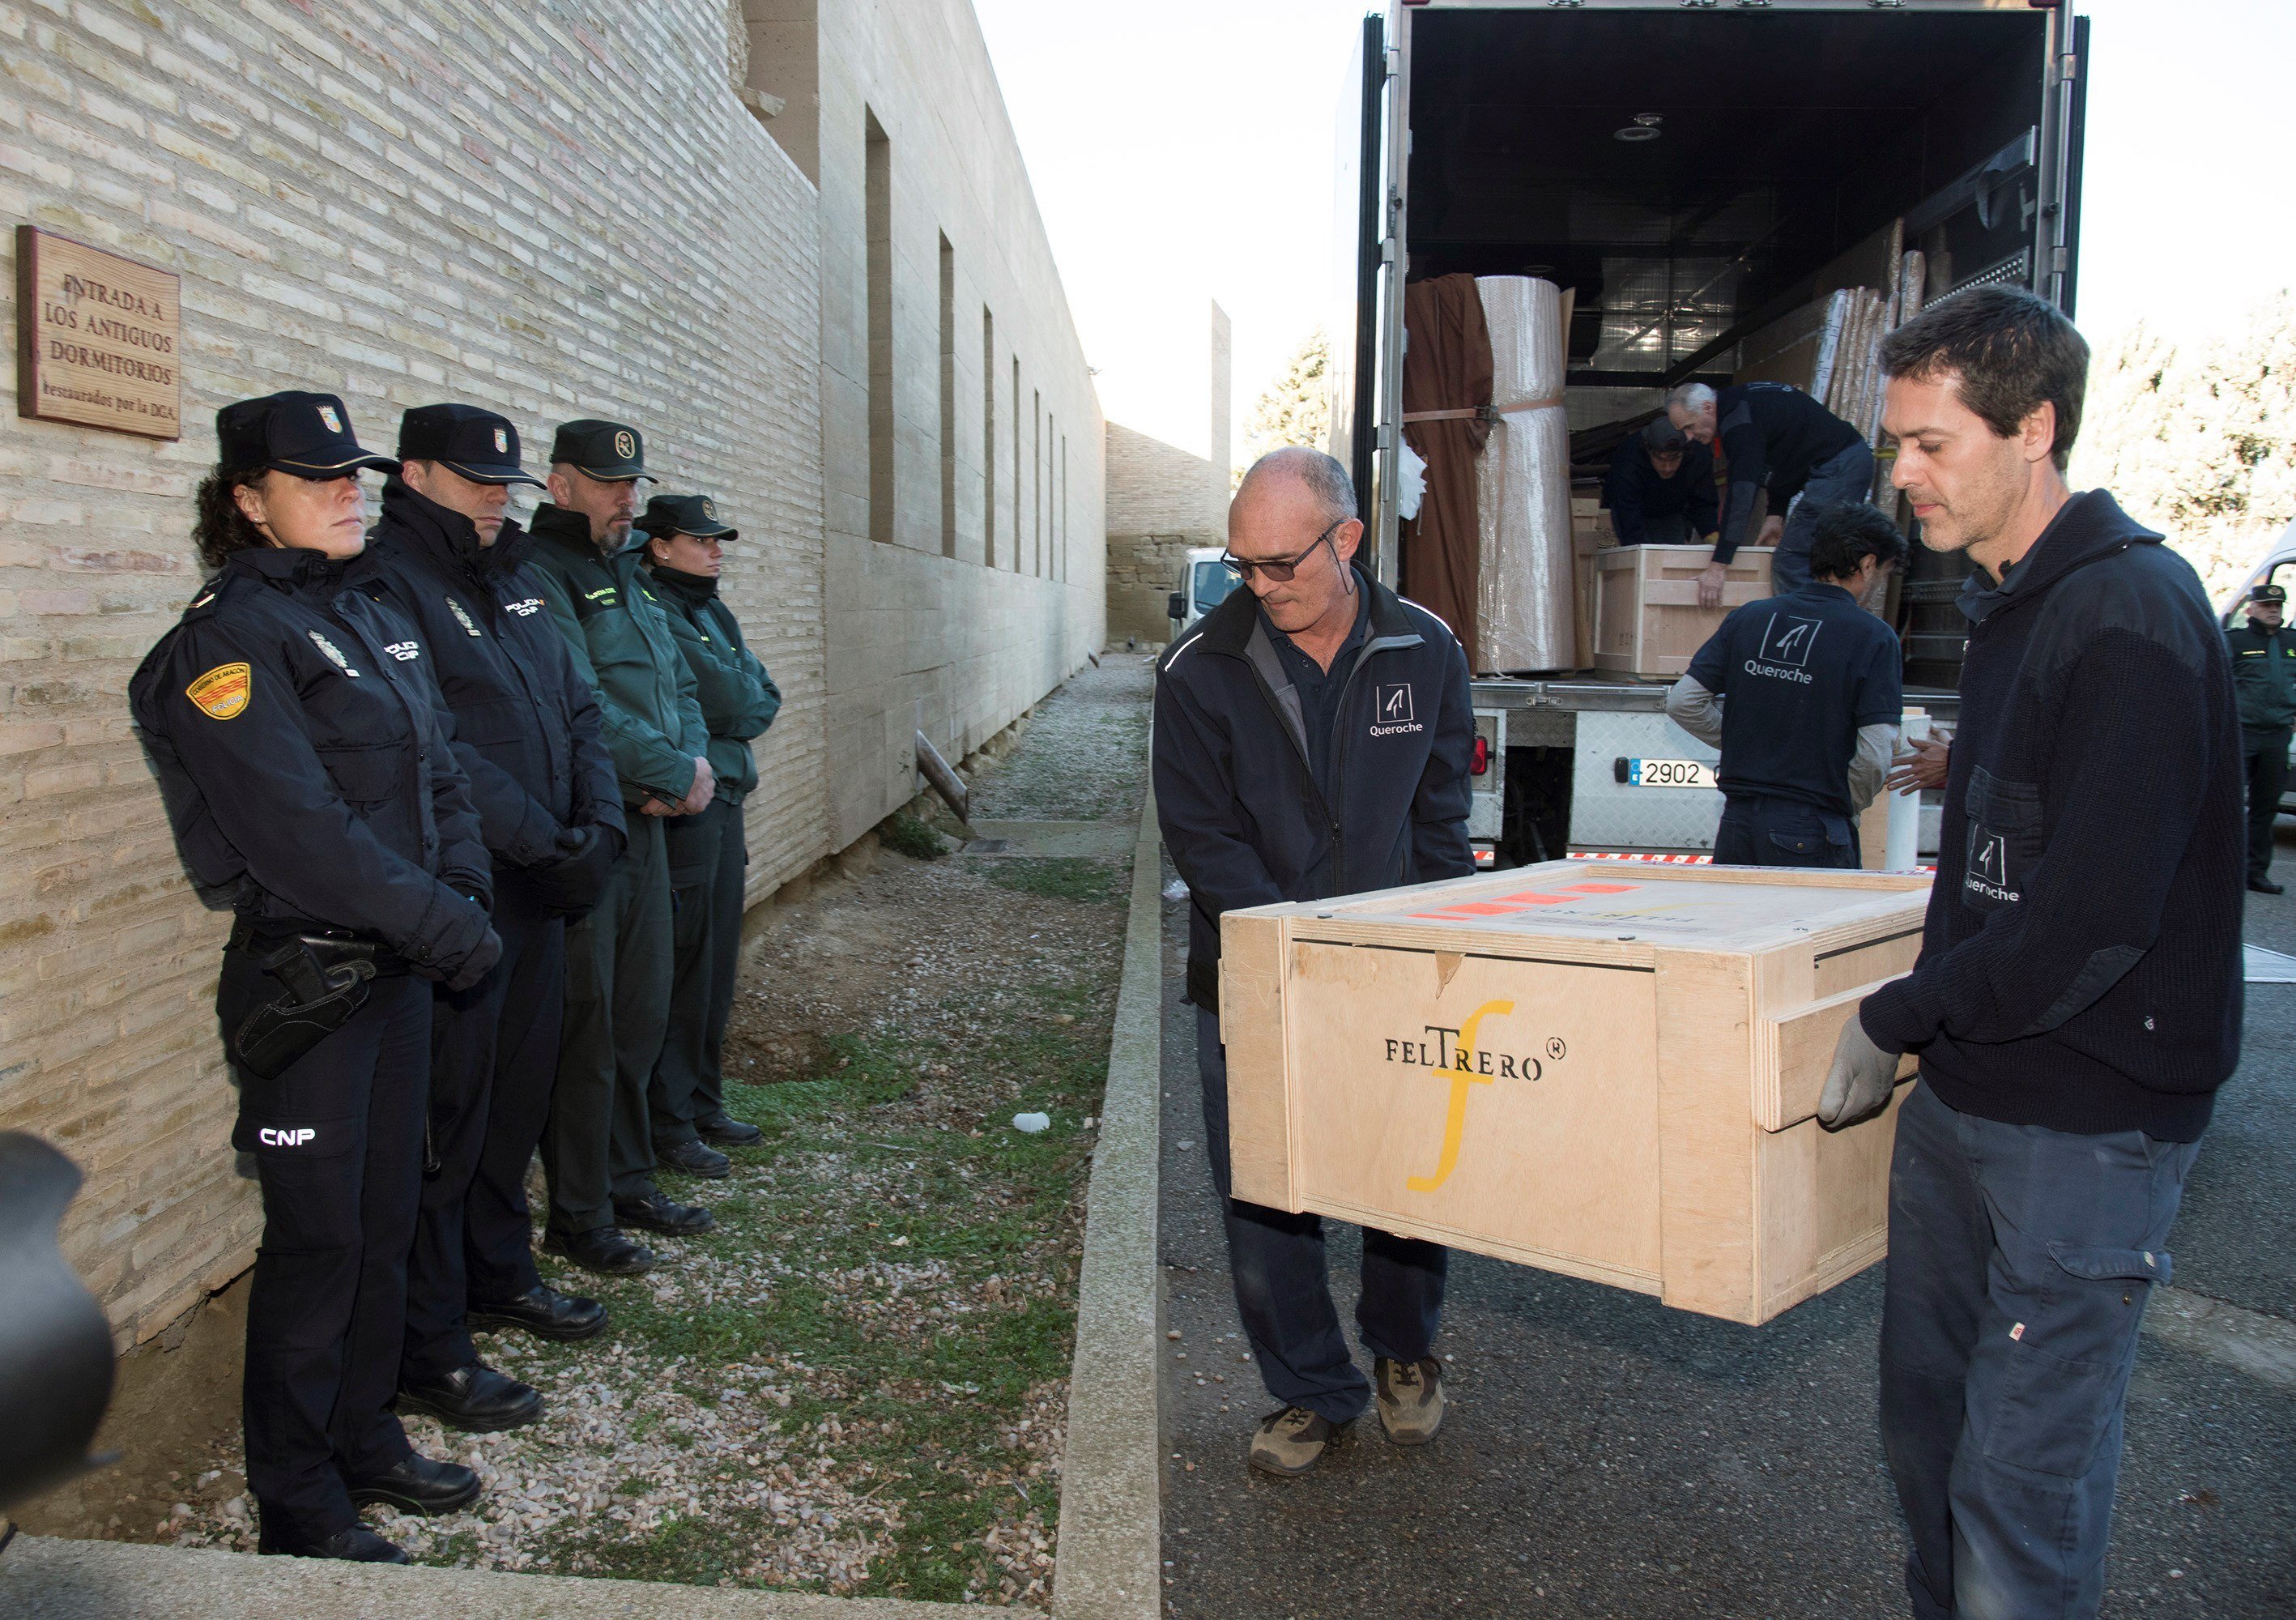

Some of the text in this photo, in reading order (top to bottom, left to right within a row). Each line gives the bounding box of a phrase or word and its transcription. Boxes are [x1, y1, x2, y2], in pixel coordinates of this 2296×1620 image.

[63, 273, 164, 322] ENTRADA A
[45, 301, 173, 353] LOS ANTIGUOS
[50, 340, 173, 386] DORMITORIOS
[1744, 660, 1813, 684] Queroche
[1370, 723, 1424, 737] Queroche
[1646, 763, 1699, 784] 2902
[1965, 873, 2020, 902] ueroche
[1384, 1025, 1543, 1081] FELTRERO
[260, 1128, 316, 1145] CNP
